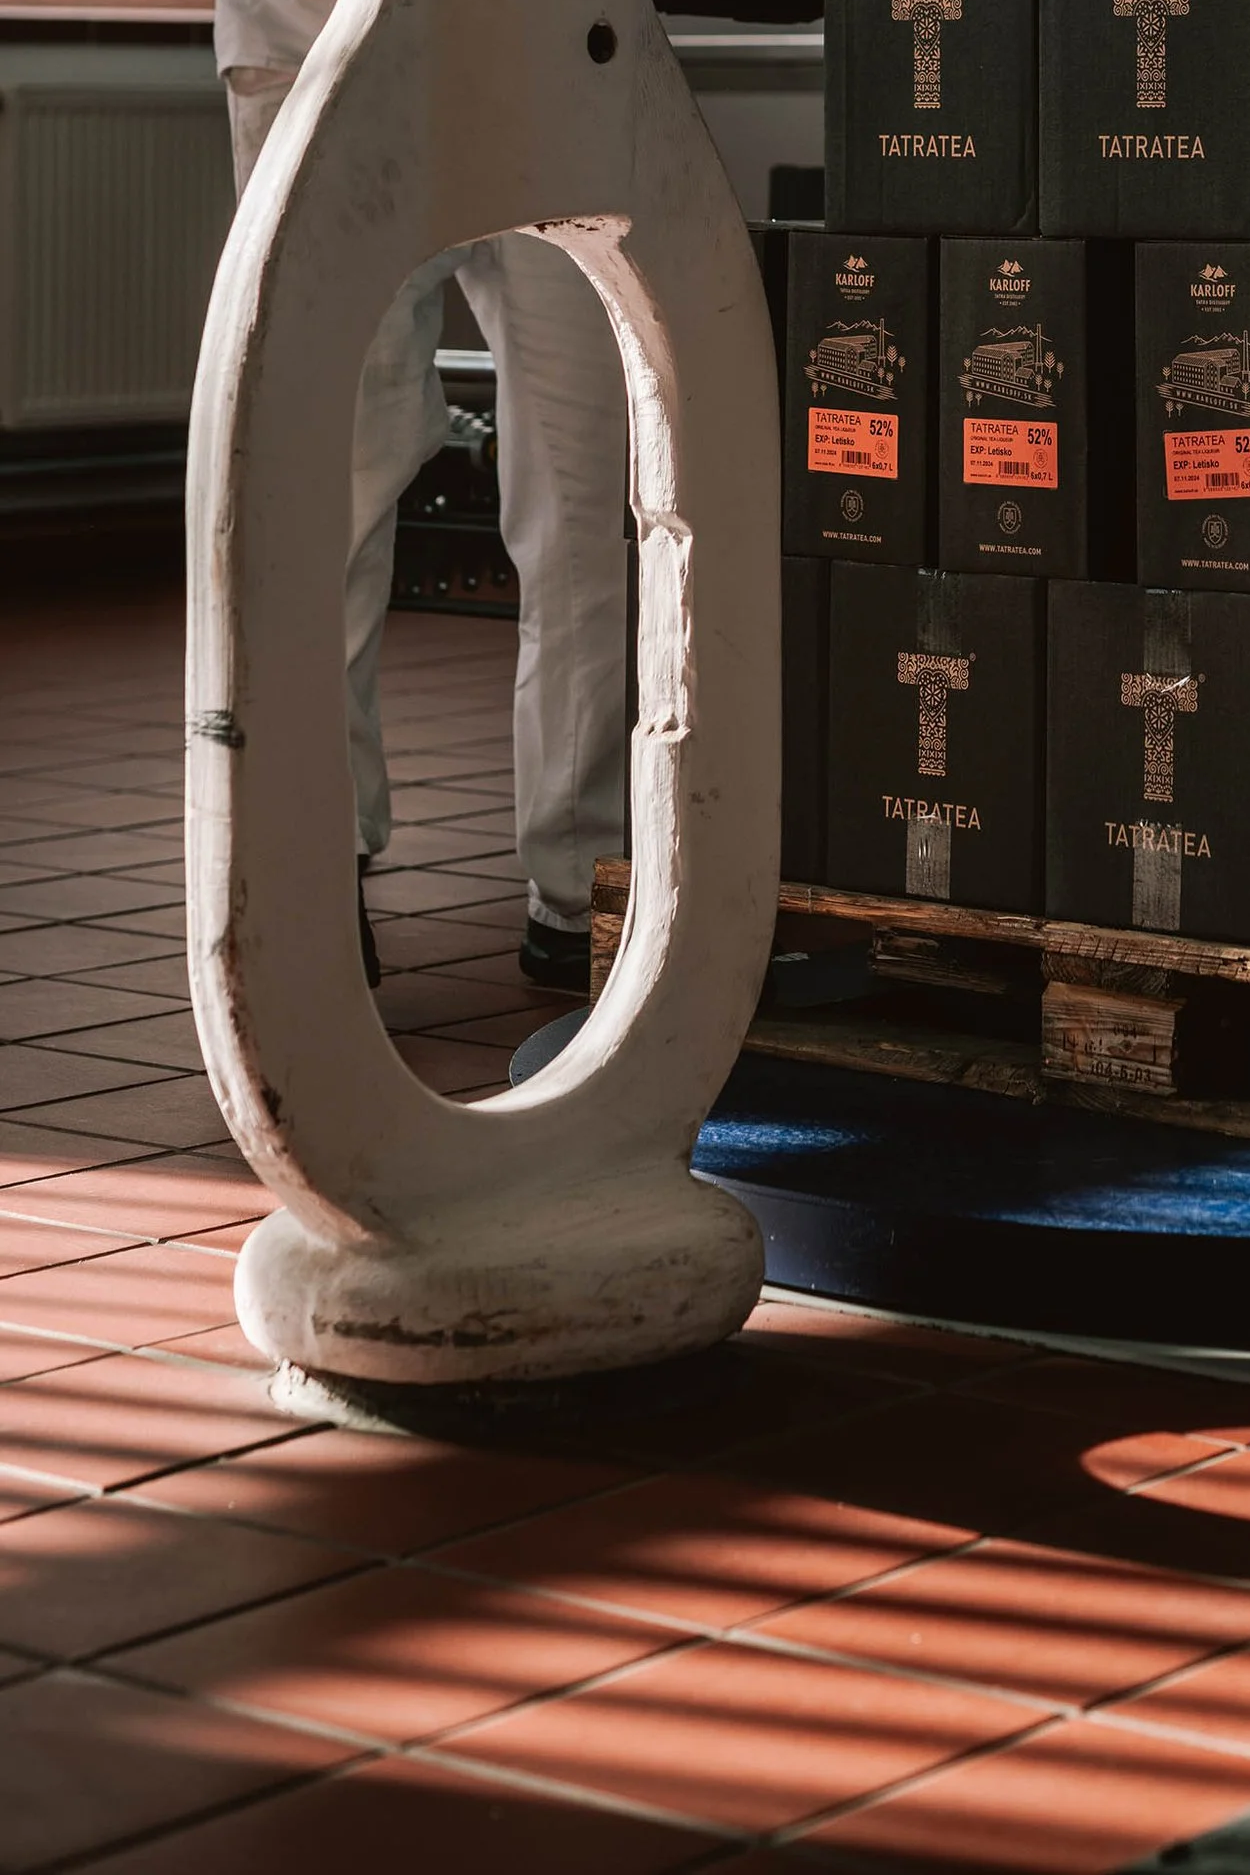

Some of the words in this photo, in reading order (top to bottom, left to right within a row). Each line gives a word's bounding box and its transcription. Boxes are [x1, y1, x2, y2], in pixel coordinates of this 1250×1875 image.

[878, 133, 976, 159] TATRATEA
[1098, 133, 1206, 160] TATRATEA
[835, 273, 875, 287] KARLOFF
[989, 278, 1031, 292] KARLOFF
[1191, 284, 1236, 297] KARLOFF
[815, 412, 861, 425] TATRATEA
[869, 419, 893, 437] 52%
[971, 422, 1018, 435] TATRATEA
[815, 434, 830, 444] EXP:
[832, 435, 855, 446] Letisko
[1028, 428, 1052, 445] 52%
[1172, 435, 1225, 447] TATRATEA
[970, 445, 987, 455] EXP:
[988, 446, 1012, 456] Letisko
[1173, 460, 1192, 469] EXP:
[1193, 460, 1219, 469] Letisko
[822, 530, 882, 543] WWW.TATRATEA.COM
[979, 544, 1042, 556] WWW.TATRATEA.COM
[1181, 559, 1249, 571] WWW.TATRATEA.COM
[881, 794, 981, 829] TATRATEA
[1104, 821, 1212, 858] TATRATEA
